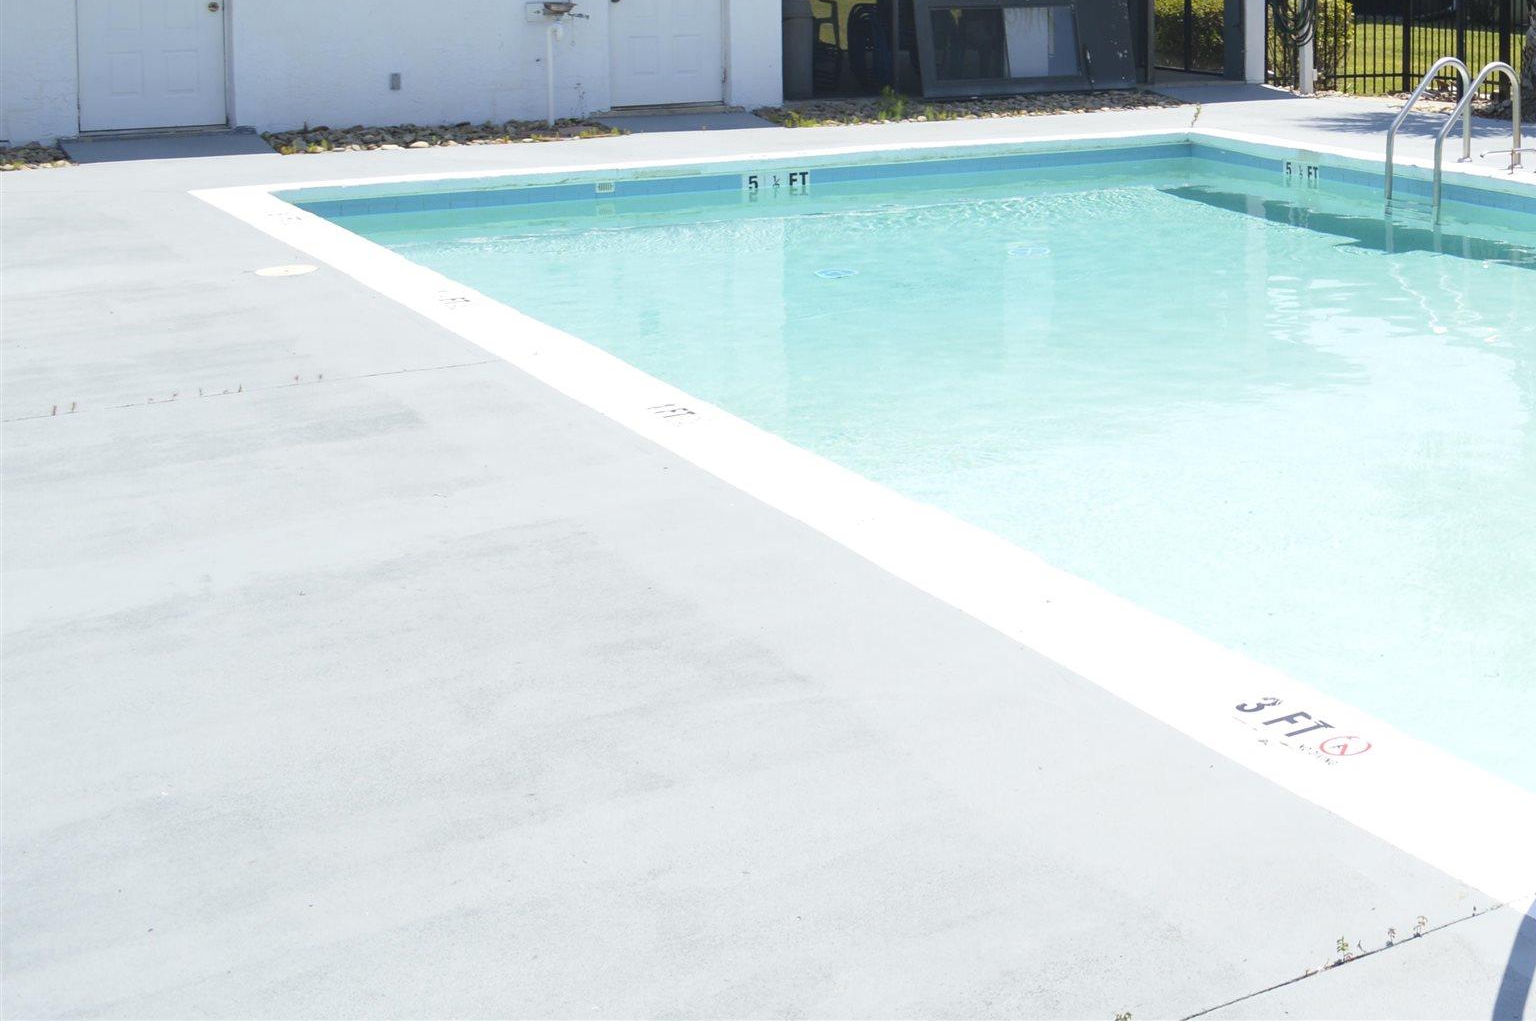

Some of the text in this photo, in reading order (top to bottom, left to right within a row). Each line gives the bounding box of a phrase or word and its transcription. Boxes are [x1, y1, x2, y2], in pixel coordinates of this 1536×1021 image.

[1286, 162, 1292, 175] 5
[1307, 165, 1319, 179] FT
[748, 175, 759, 189] 5
[789, 171, 809, 186] FT
[1235, 696, 1336, 738] 3 FT
